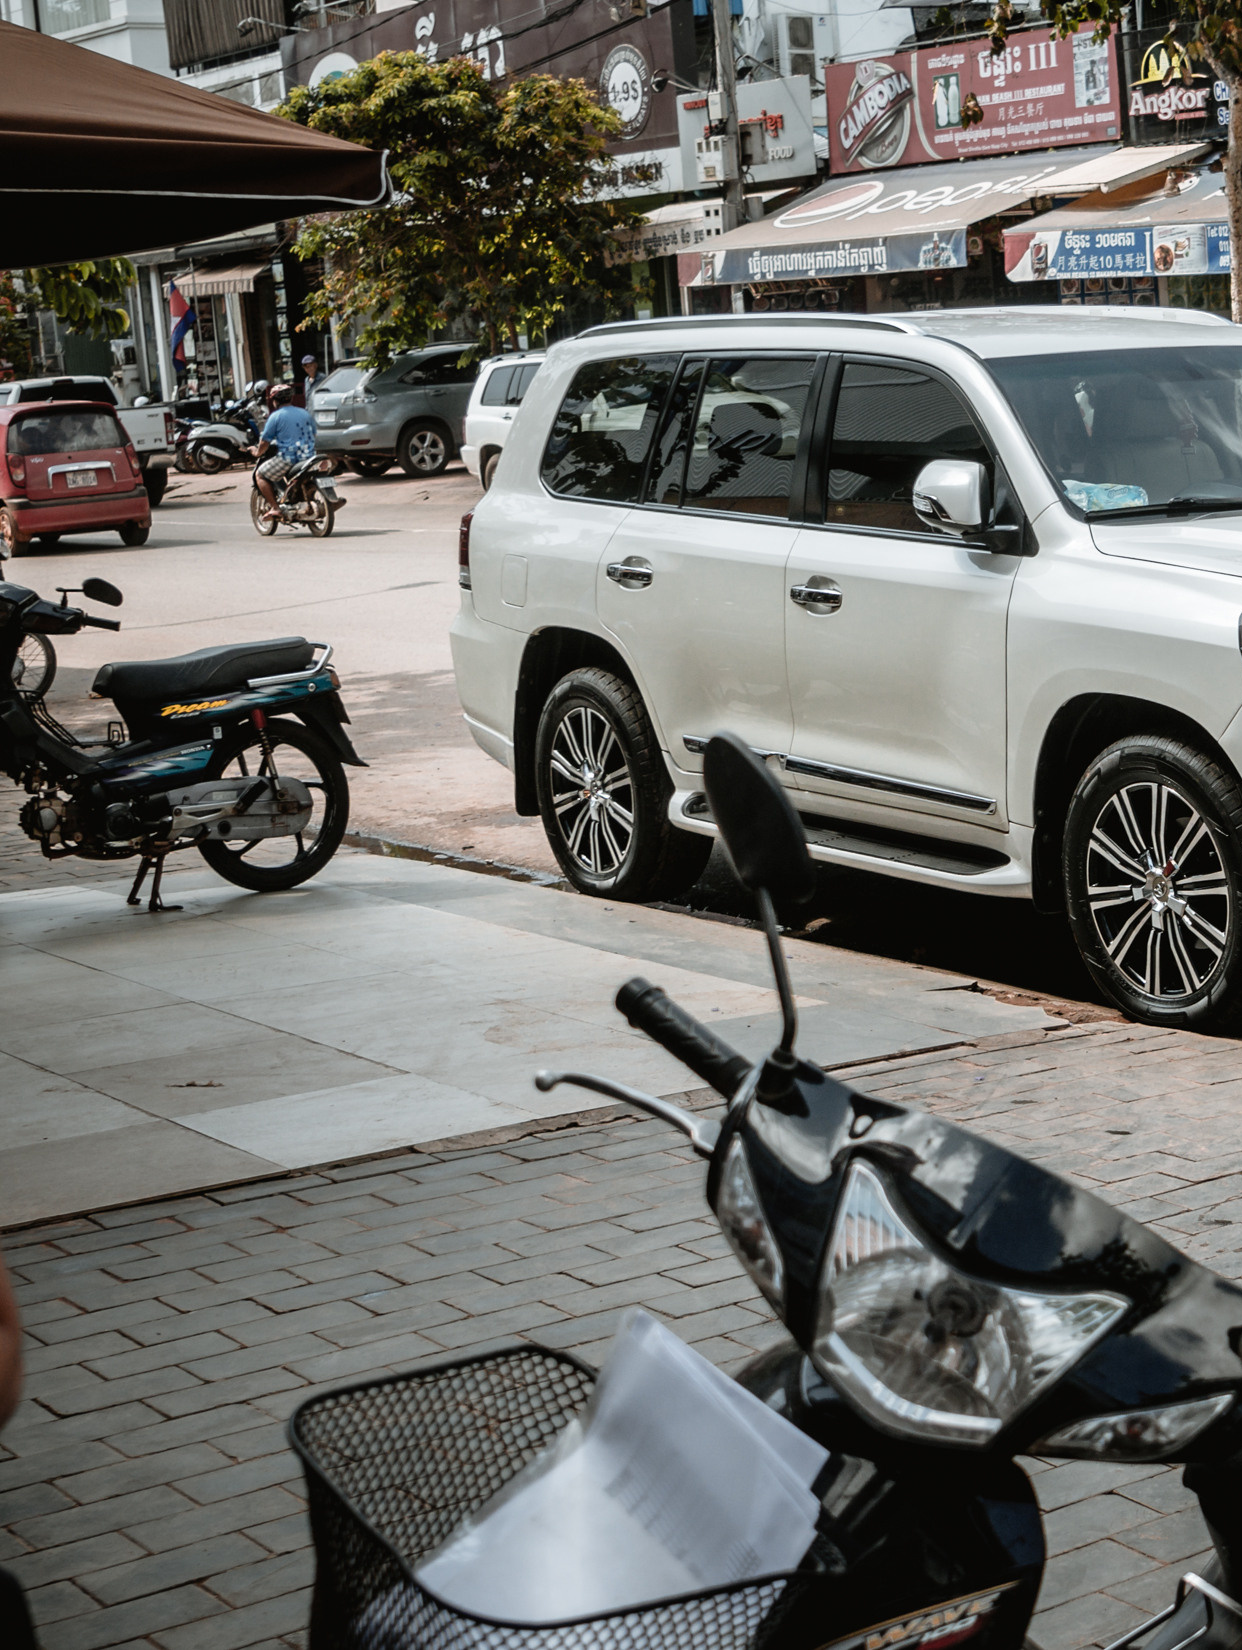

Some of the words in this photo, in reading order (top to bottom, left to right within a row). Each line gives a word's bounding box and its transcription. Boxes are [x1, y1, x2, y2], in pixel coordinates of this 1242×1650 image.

[1027, 41, 1059, 72] III
[1024, 83, 1066, 98] RESTAURANT
[840, 72, 911, 150] CAMBODIA
[1129, 86, 1210, 121] Angkor
[768, 146, 794, 160] FOOD
[846, 166, 1057, 221] pepsi
[161, 700, 228, 716] Dream
[180, 745, 205, 755] HONDA
